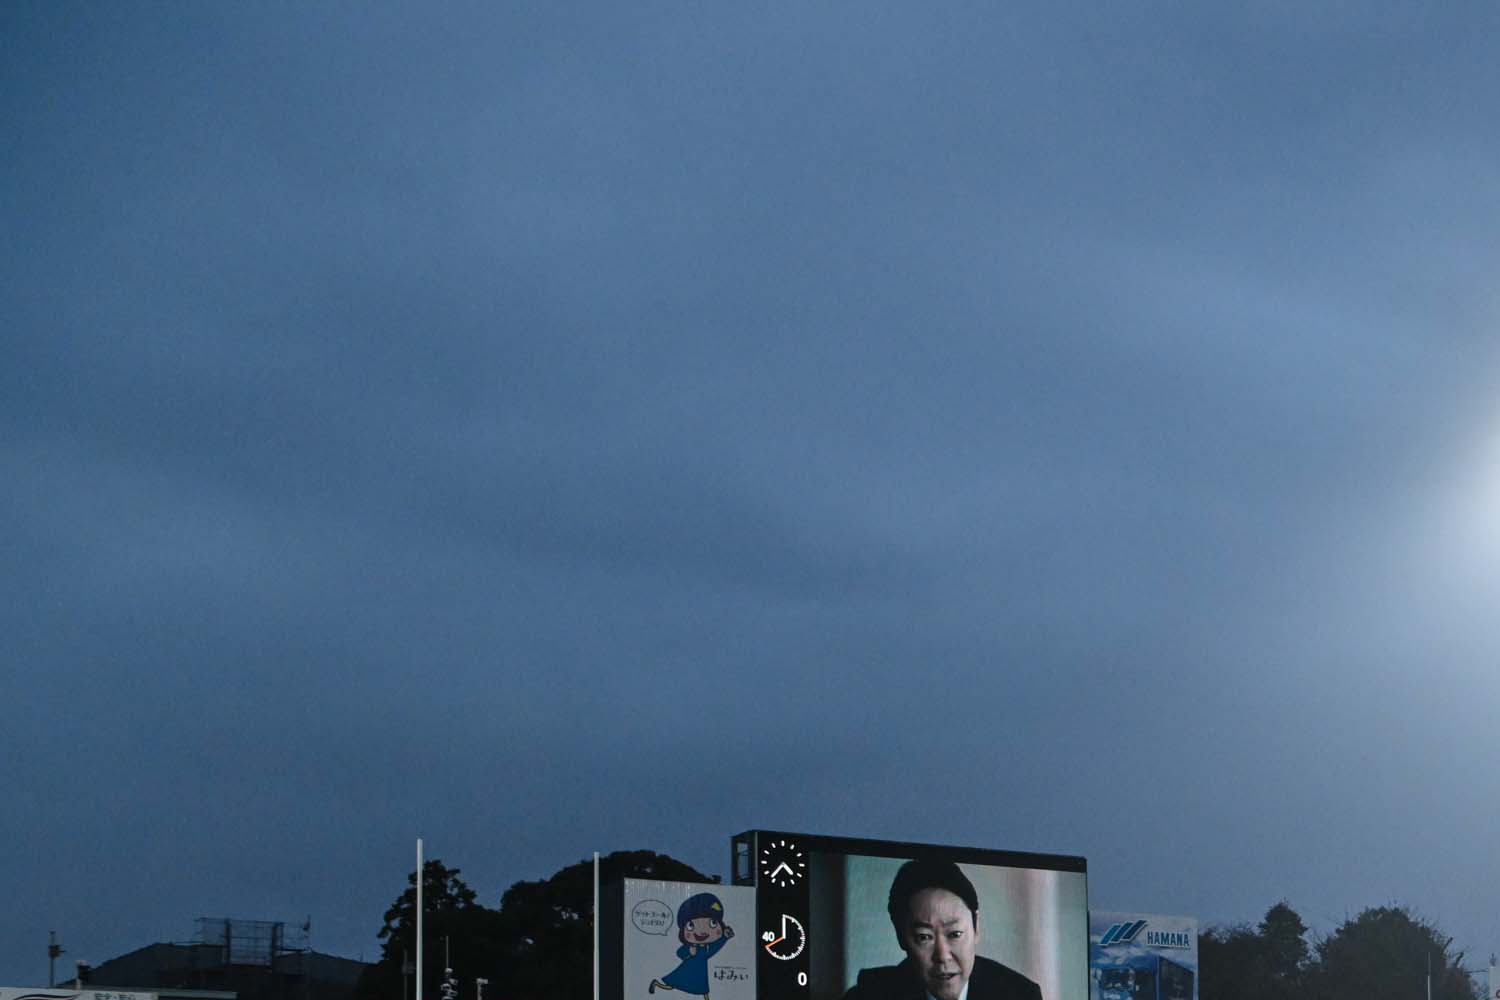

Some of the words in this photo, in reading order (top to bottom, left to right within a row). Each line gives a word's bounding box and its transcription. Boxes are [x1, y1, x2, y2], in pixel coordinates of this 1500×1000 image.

[762, 931, 775, 942] 40
[1147, 931, 1190, 947] HAMANA
[797, 972, 808, 986] 0
